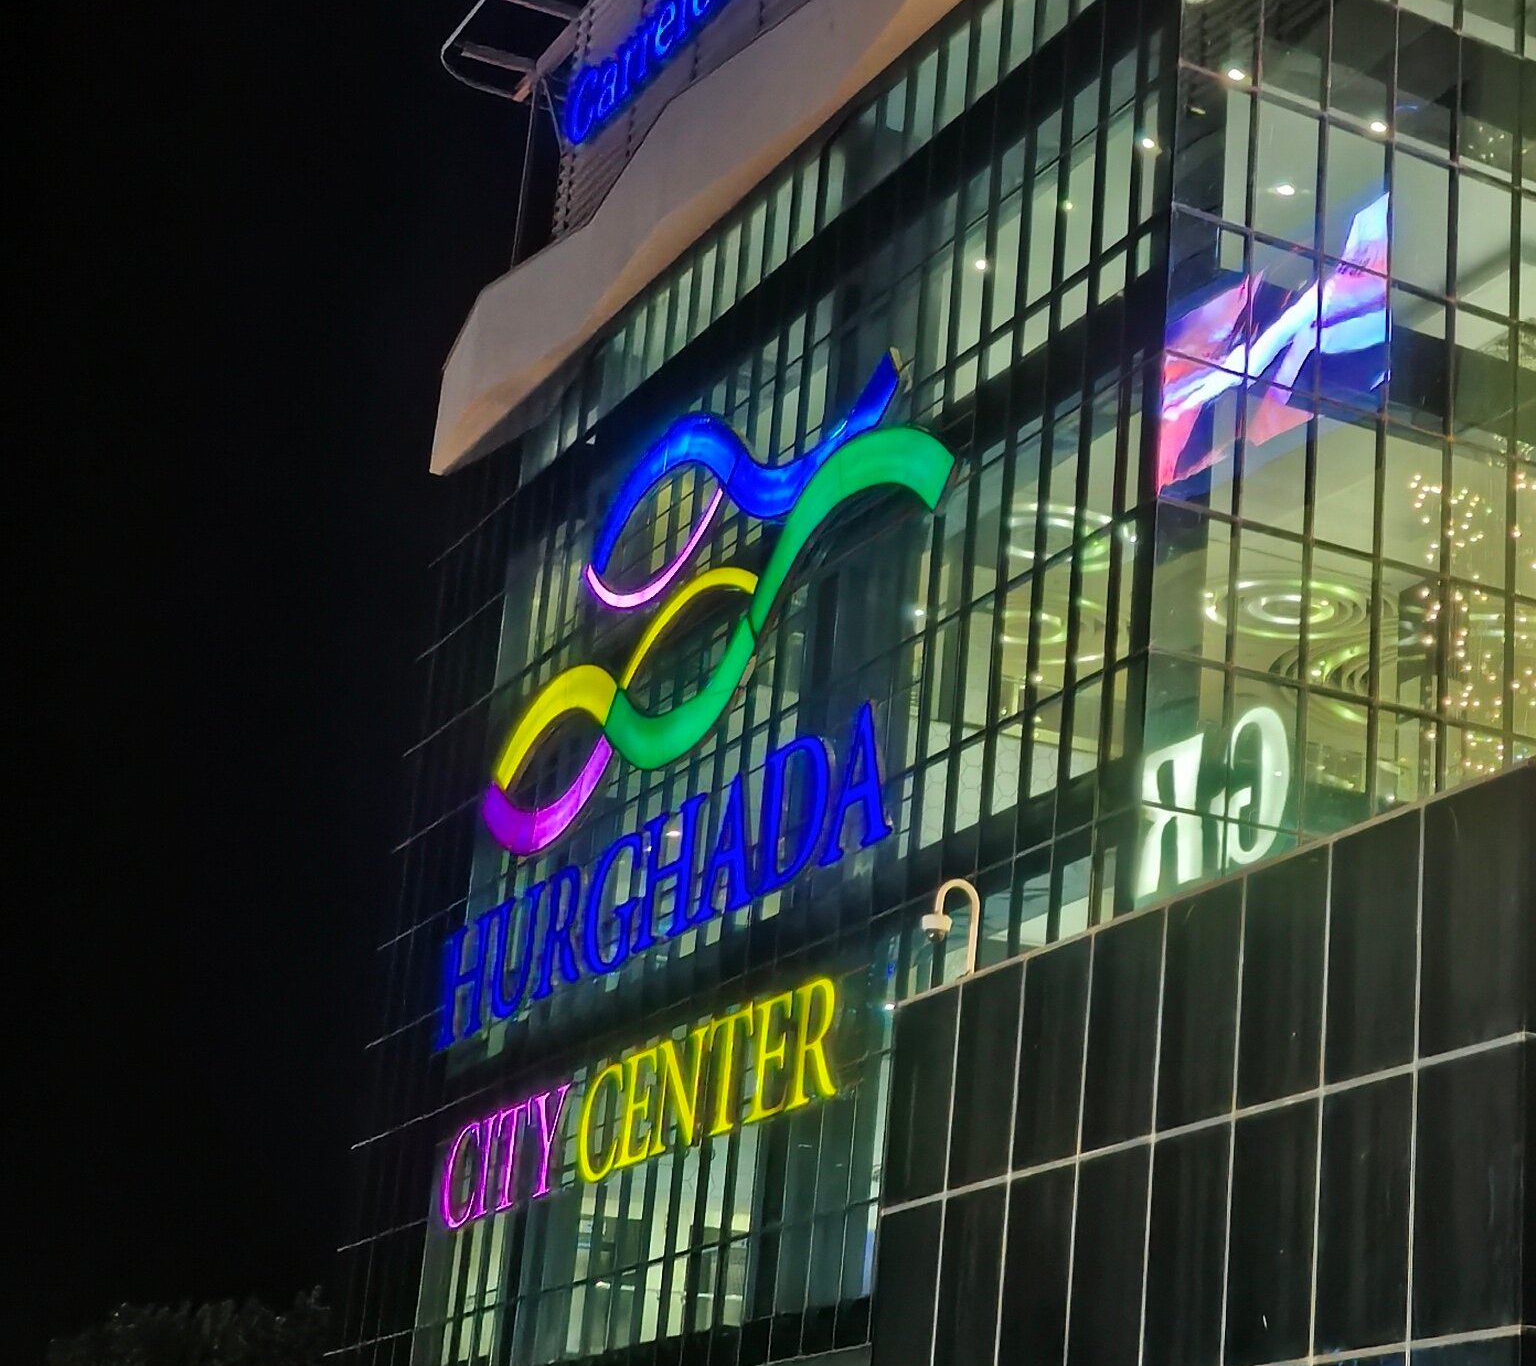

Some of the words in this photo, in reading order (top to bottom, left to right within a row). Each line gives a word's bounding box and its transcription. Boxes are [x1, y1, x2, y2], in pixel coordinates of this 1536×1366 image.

[434, 699, 893, 1051] HURGHADA
[441, 1082, 573, 1230] CITY
[576, 976, 839, 1184] CENTER
